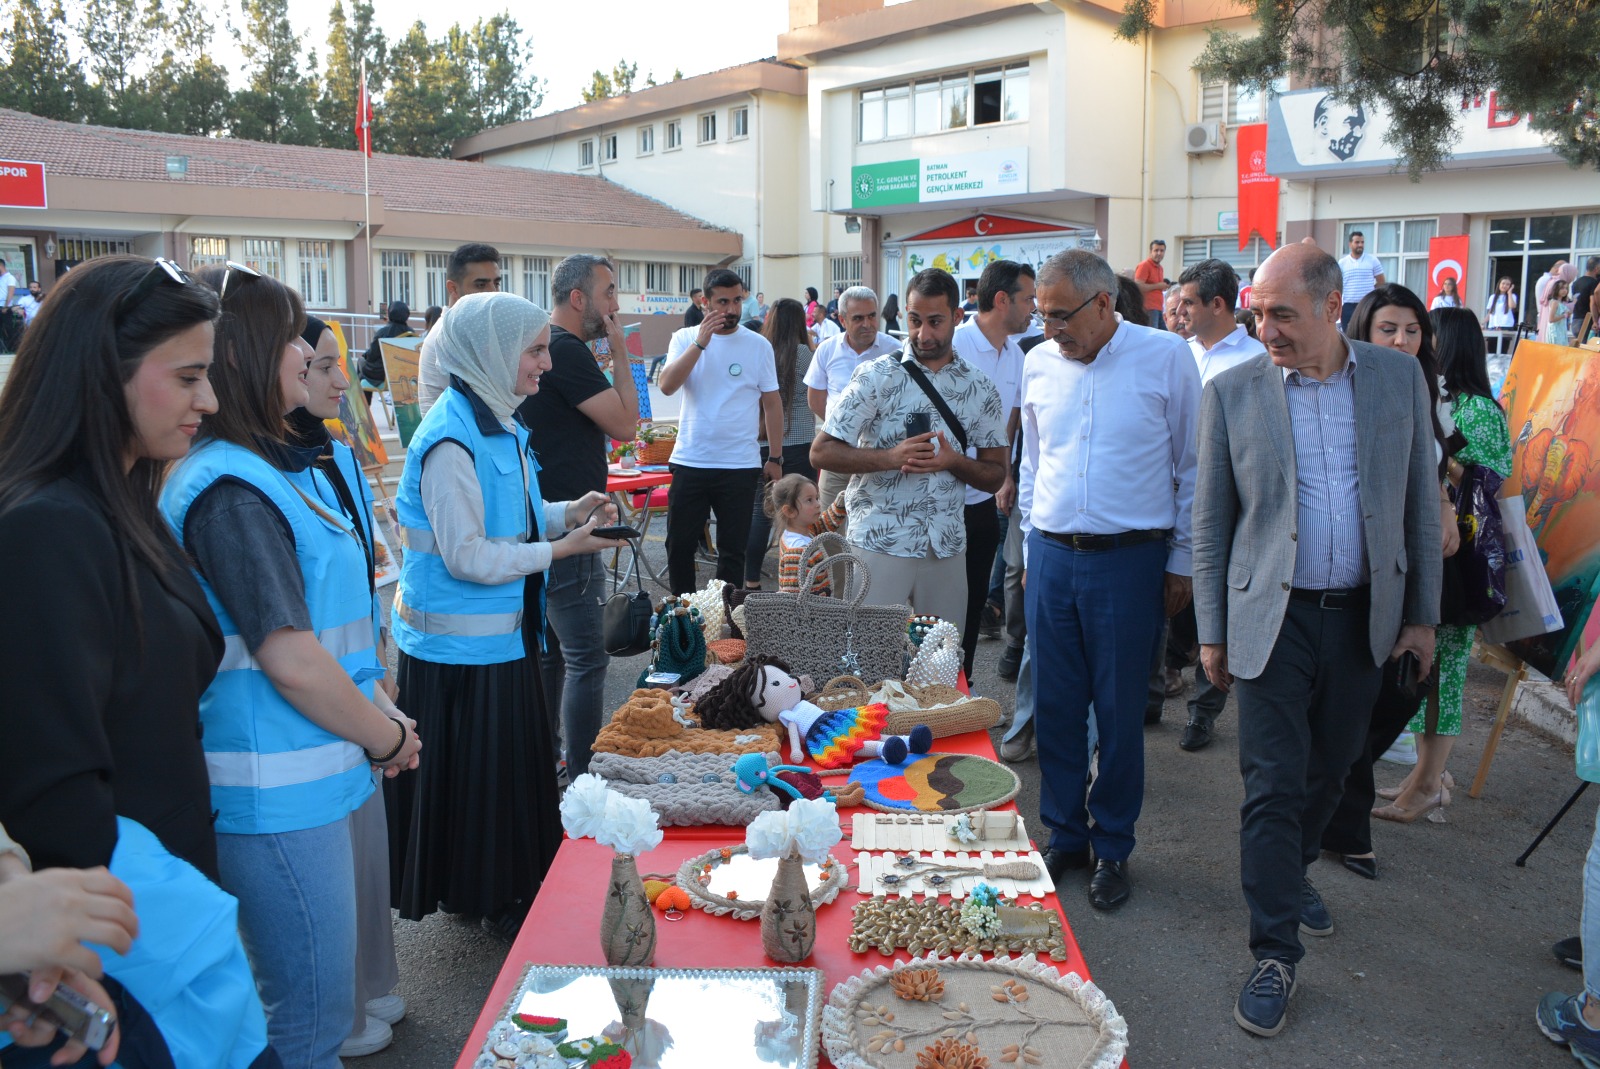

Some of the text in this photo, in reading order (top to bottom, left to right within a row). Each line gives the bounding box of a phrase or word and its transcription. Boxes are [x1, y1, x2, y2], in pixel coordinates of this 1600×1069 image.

[927, 163, 948, 171] BATMAN
[887, 175, 909, 184] GENÇLİK
[927, 171, 967, 182] PETROLKENT
[890, 181, 917, 190] BAKANLIĞI
[927, 182, 953, 195] GENÇLİK
[955, 180, 984, 191] MERKEZİ
